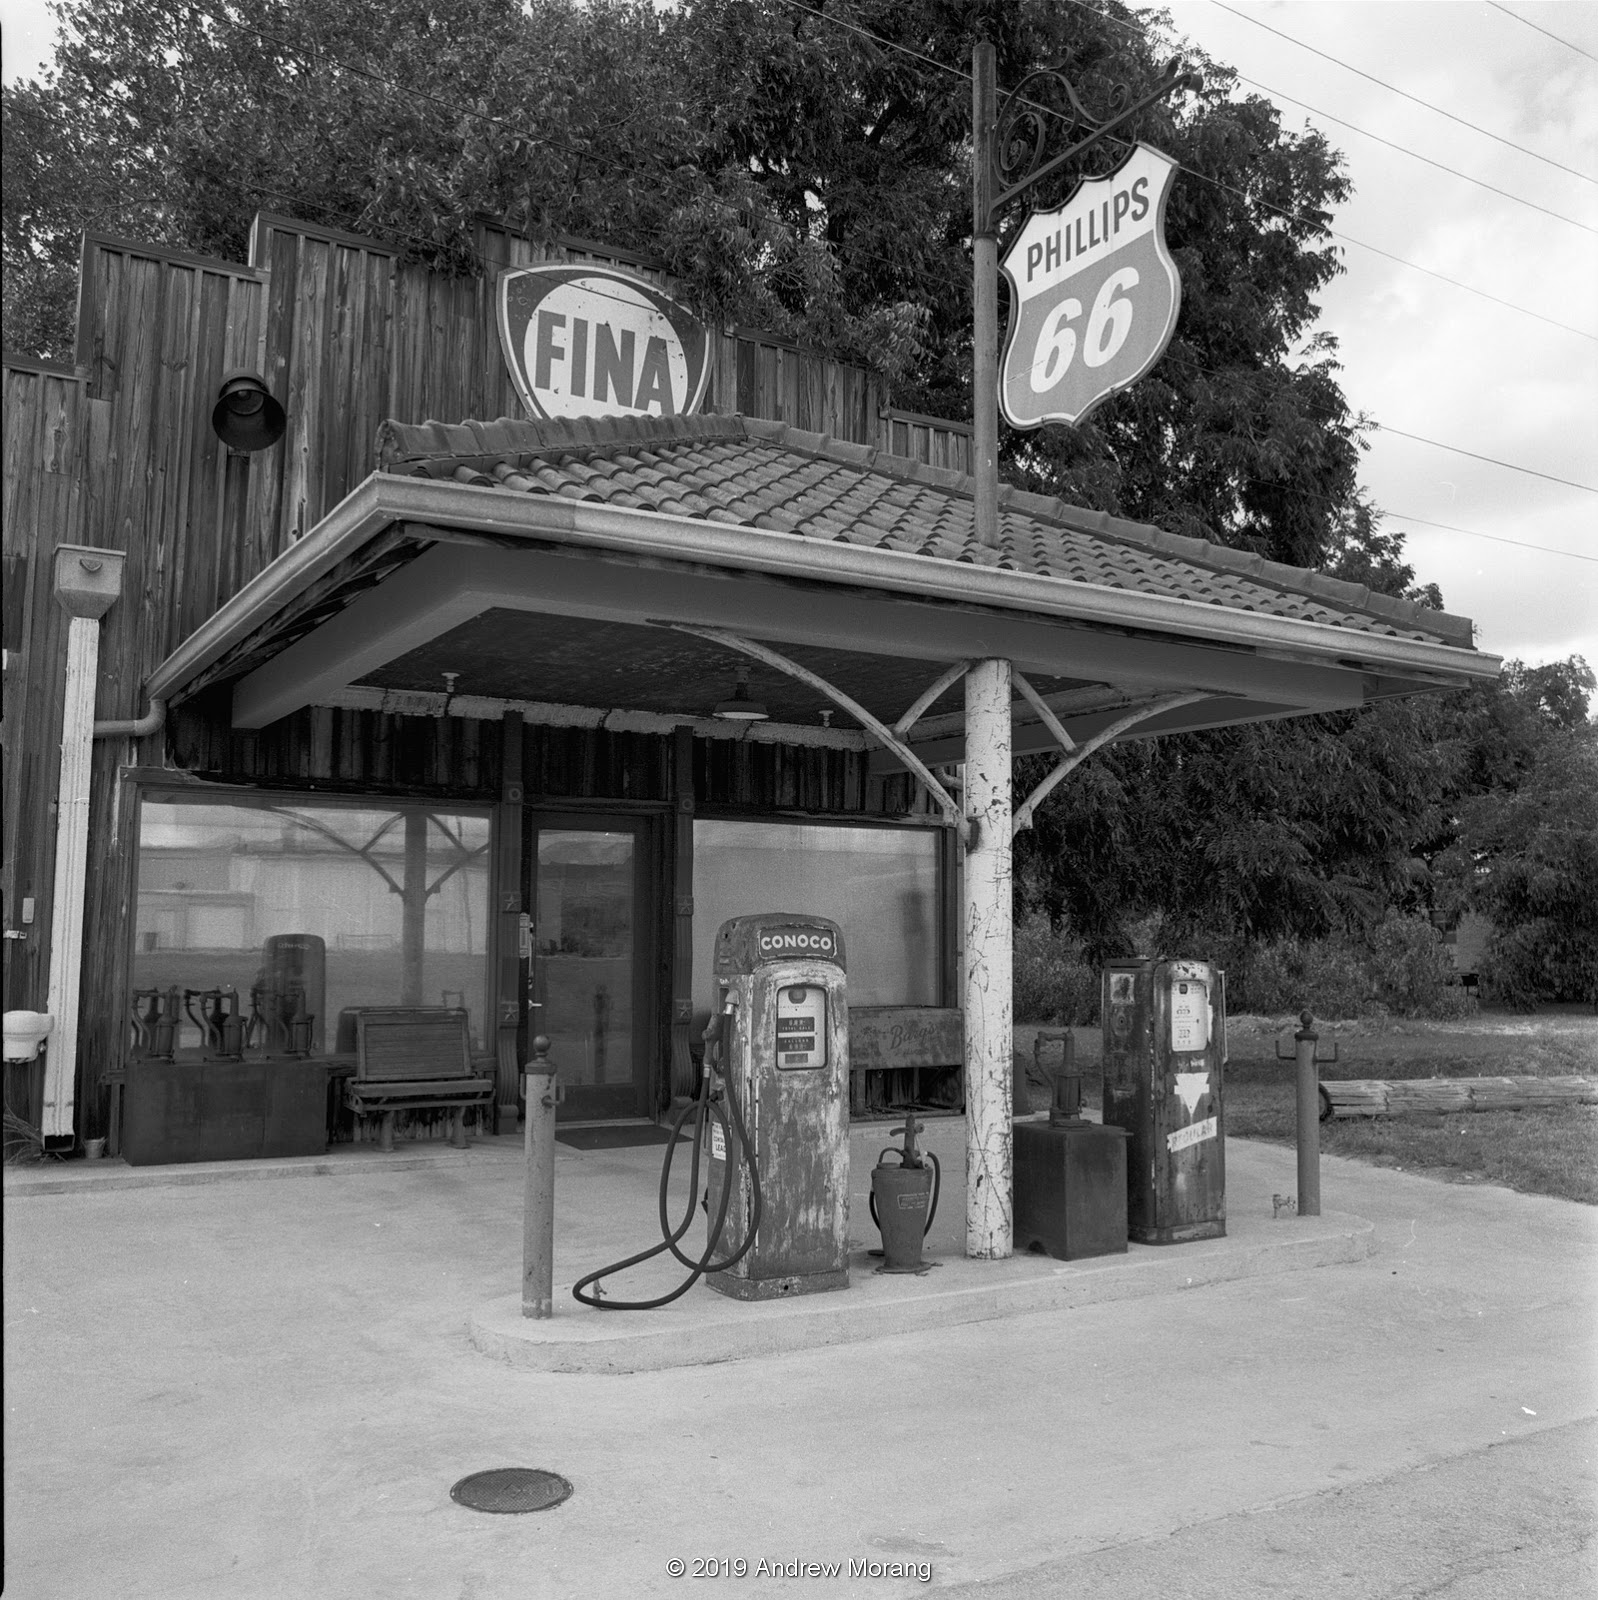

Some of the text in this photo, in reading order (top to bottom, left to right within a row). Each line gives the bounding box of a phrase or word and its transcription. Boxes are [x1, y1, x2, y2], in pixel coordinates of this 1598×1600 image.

[1027, 176, 1150, 283] PHILLIPS
[535, 308, 675, 415] FINA
[1030, 266, 1140, 393] 66
[760, 934, 832, 950] CONOCO
